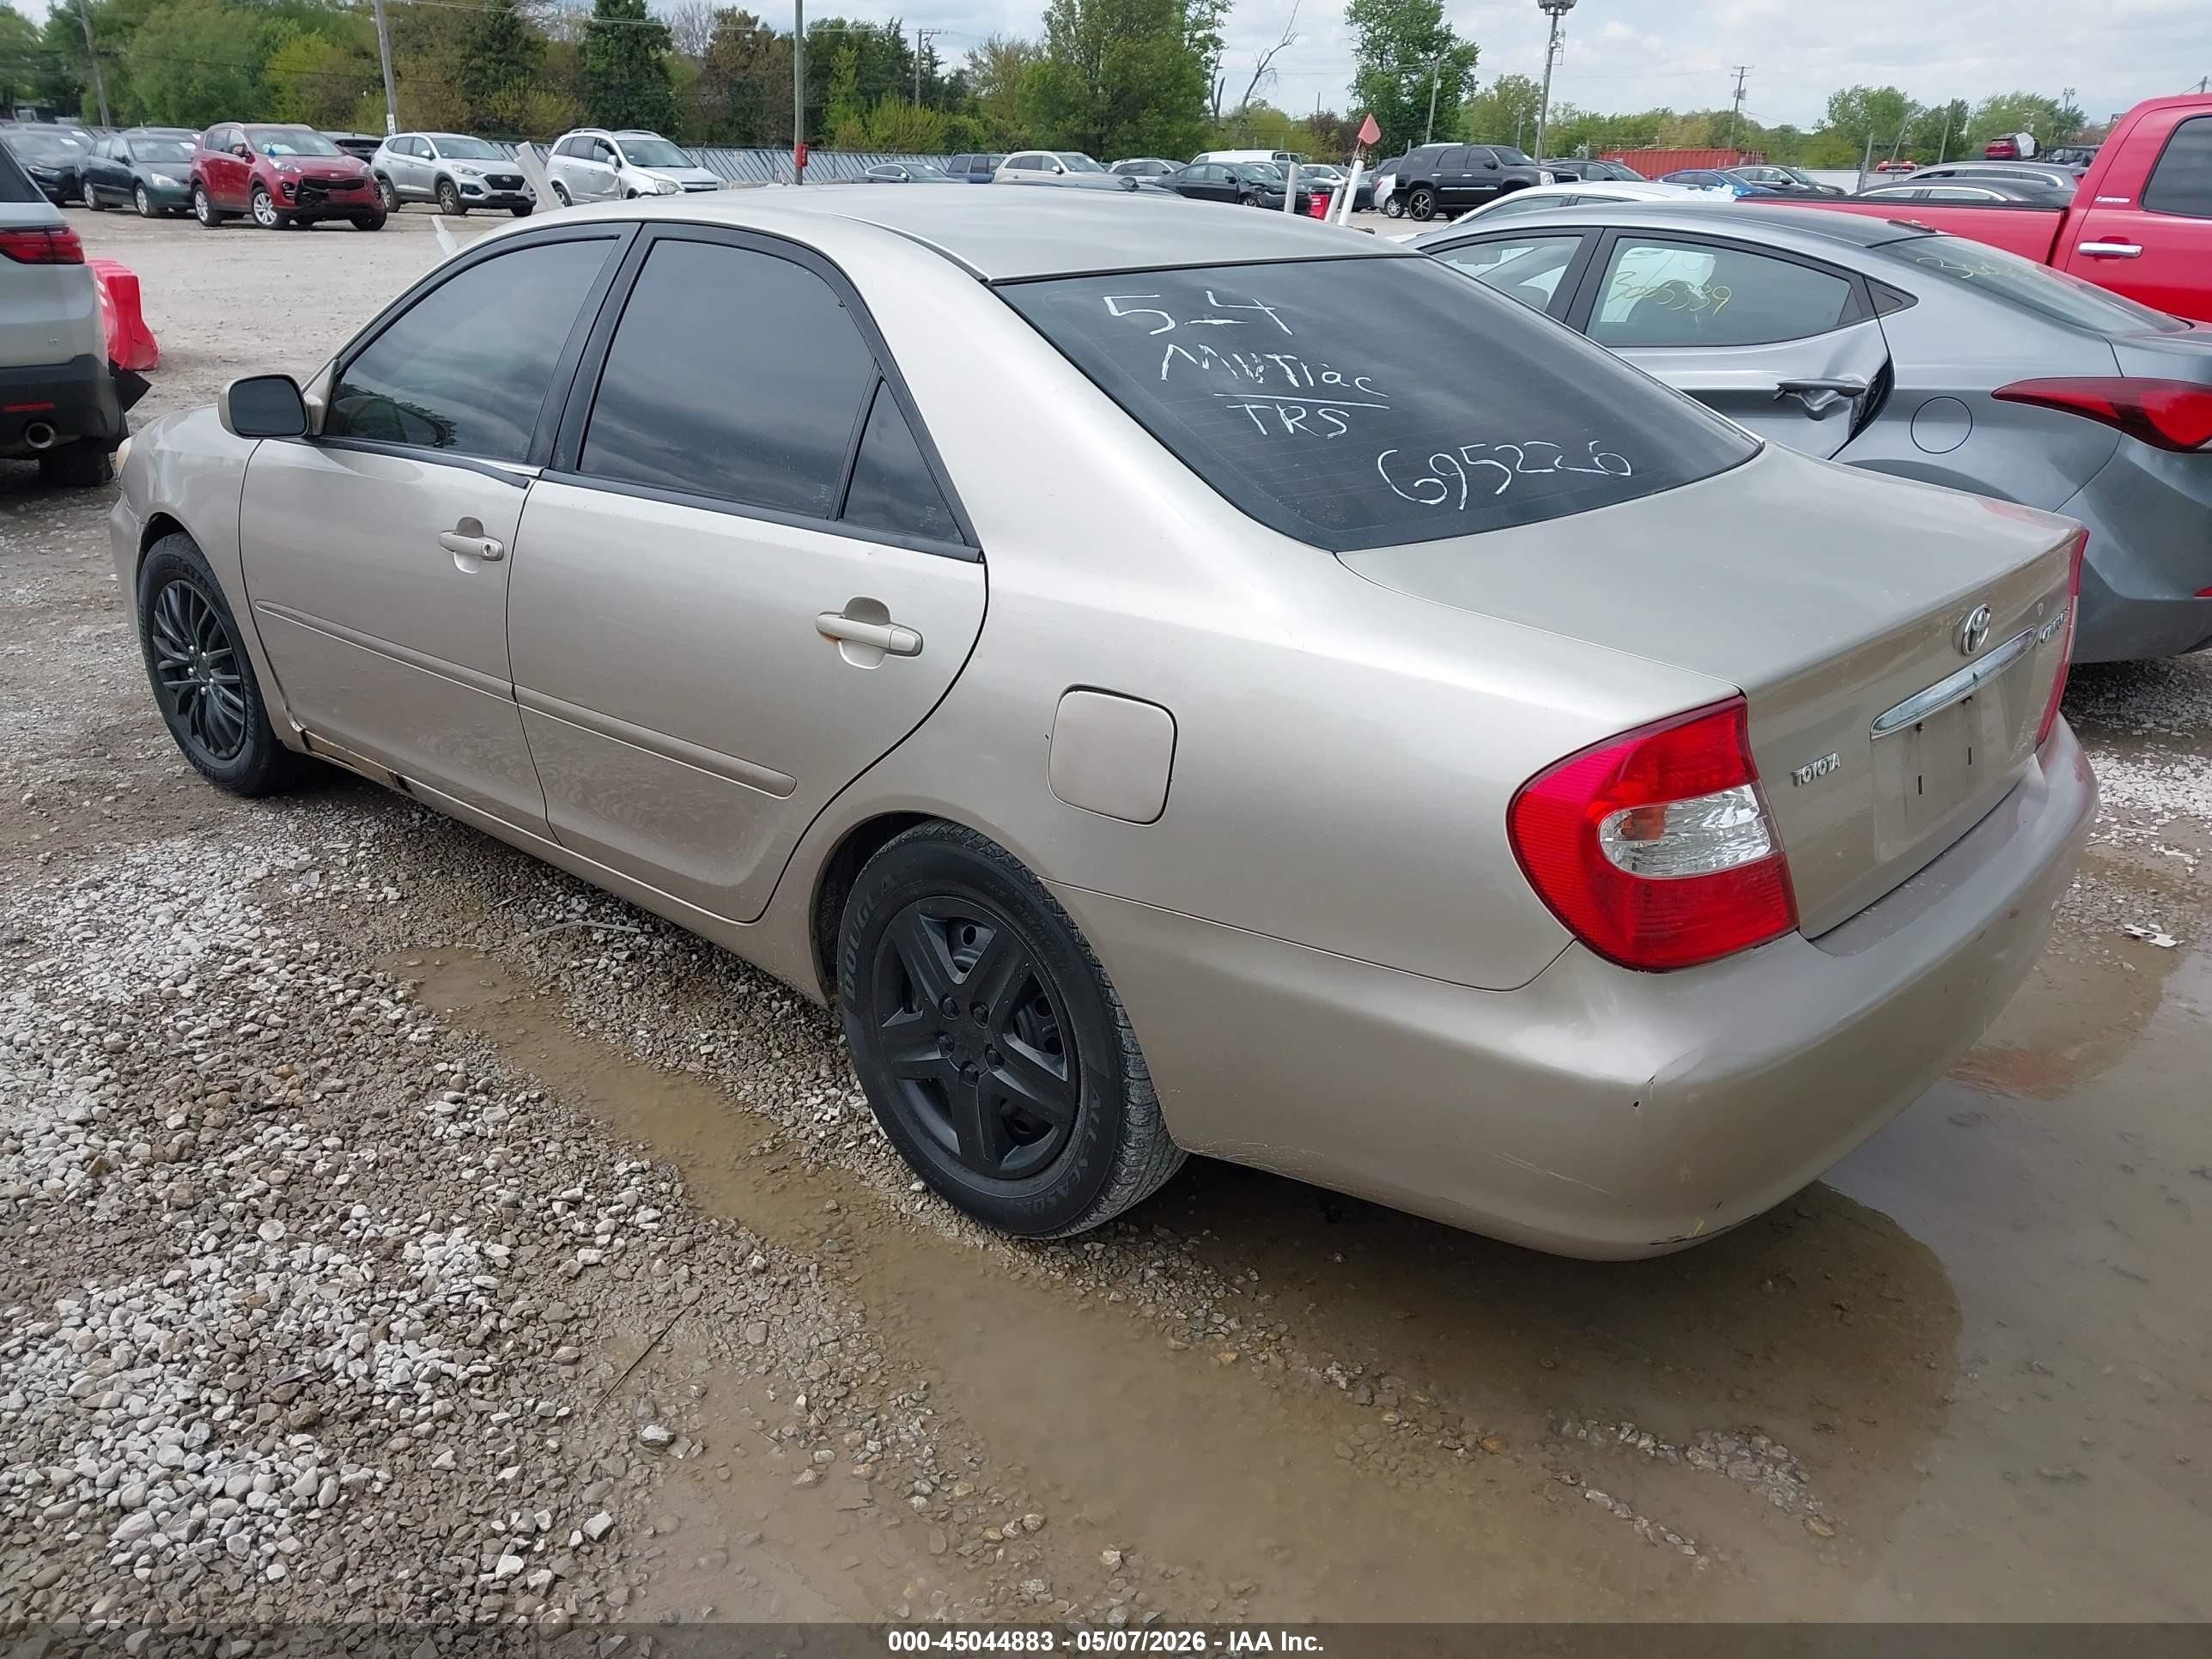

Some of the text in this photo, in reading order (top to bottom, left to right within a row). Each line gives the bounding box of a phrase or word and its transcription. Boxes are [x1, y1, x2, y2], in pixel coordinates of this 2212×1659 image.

[1103, 290, 1293, 335] 5-4
[1225, 403, 1350, 439] TRS
[1792, 752, 1841, 787] TOYOTA
